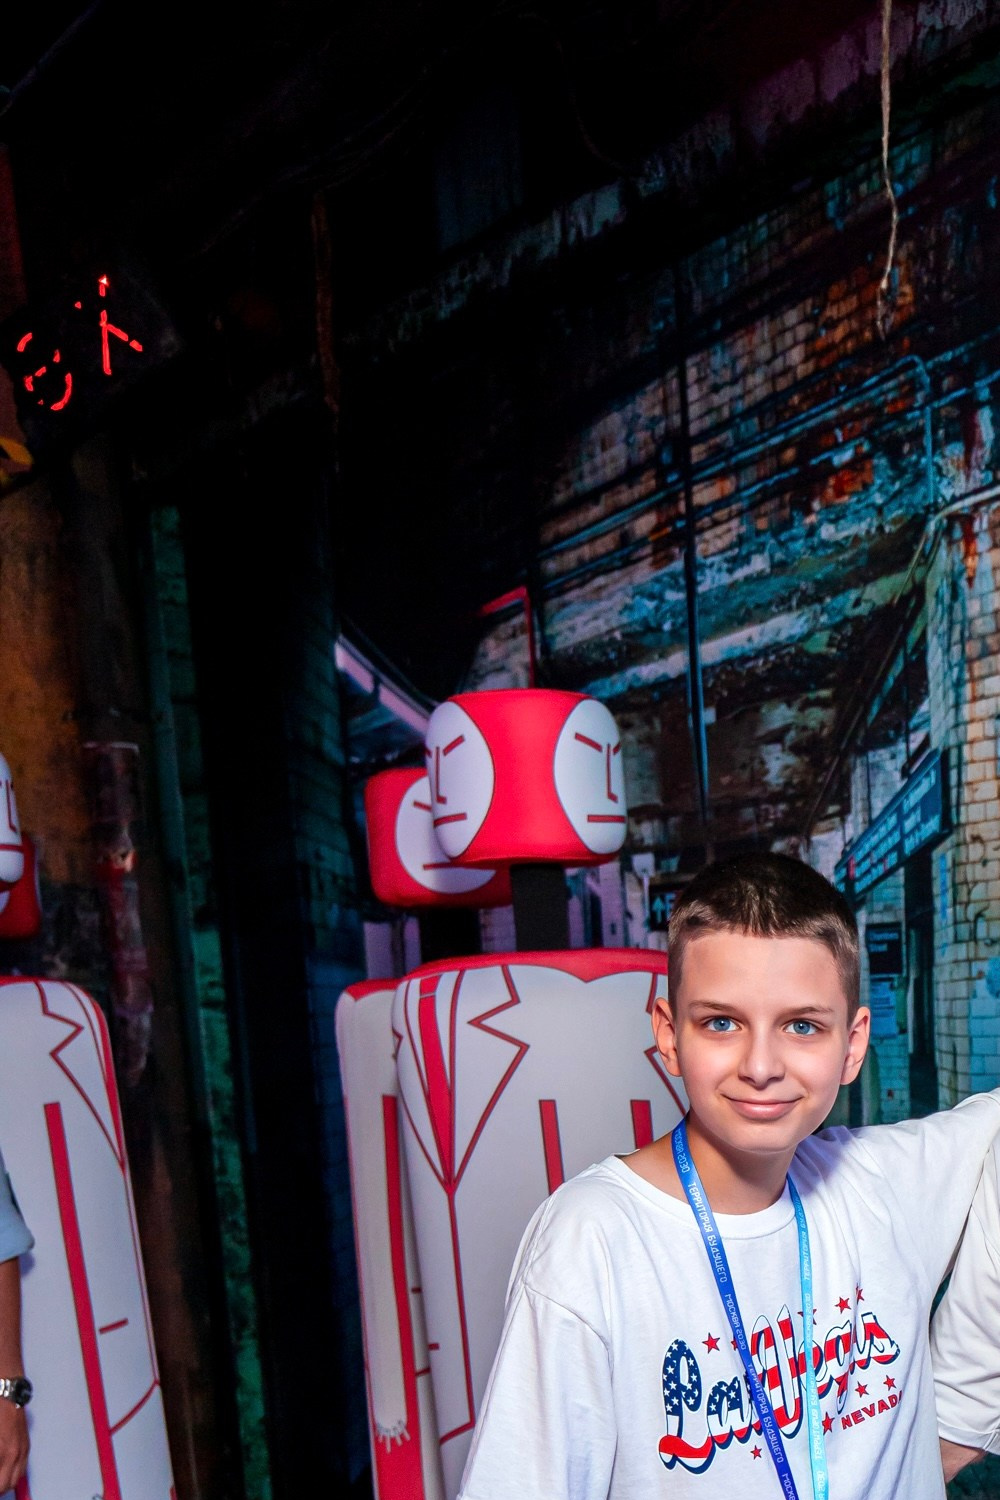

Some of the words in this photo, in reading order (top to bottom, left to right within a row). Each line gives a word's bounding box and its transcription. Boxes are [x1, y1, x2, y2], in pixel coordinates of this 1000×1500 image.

[677, 1153, 690, 1173] 2030
[688, 1182, 713, 1233] ТЕРРИТОРИЯ
[707, 1234, 728, 1283] БУДУЩЕГО
[725, 1293, 740, 1328] МОСКВА
[736, 1329, 746, 1351] 2030
[748, 1364, 769, 1415] ТЕРРИТОРИЯ
[763, 1416, 784, 1464] БУДУЩЕГО
[841, 1390, 902, 1430] NEVAD
